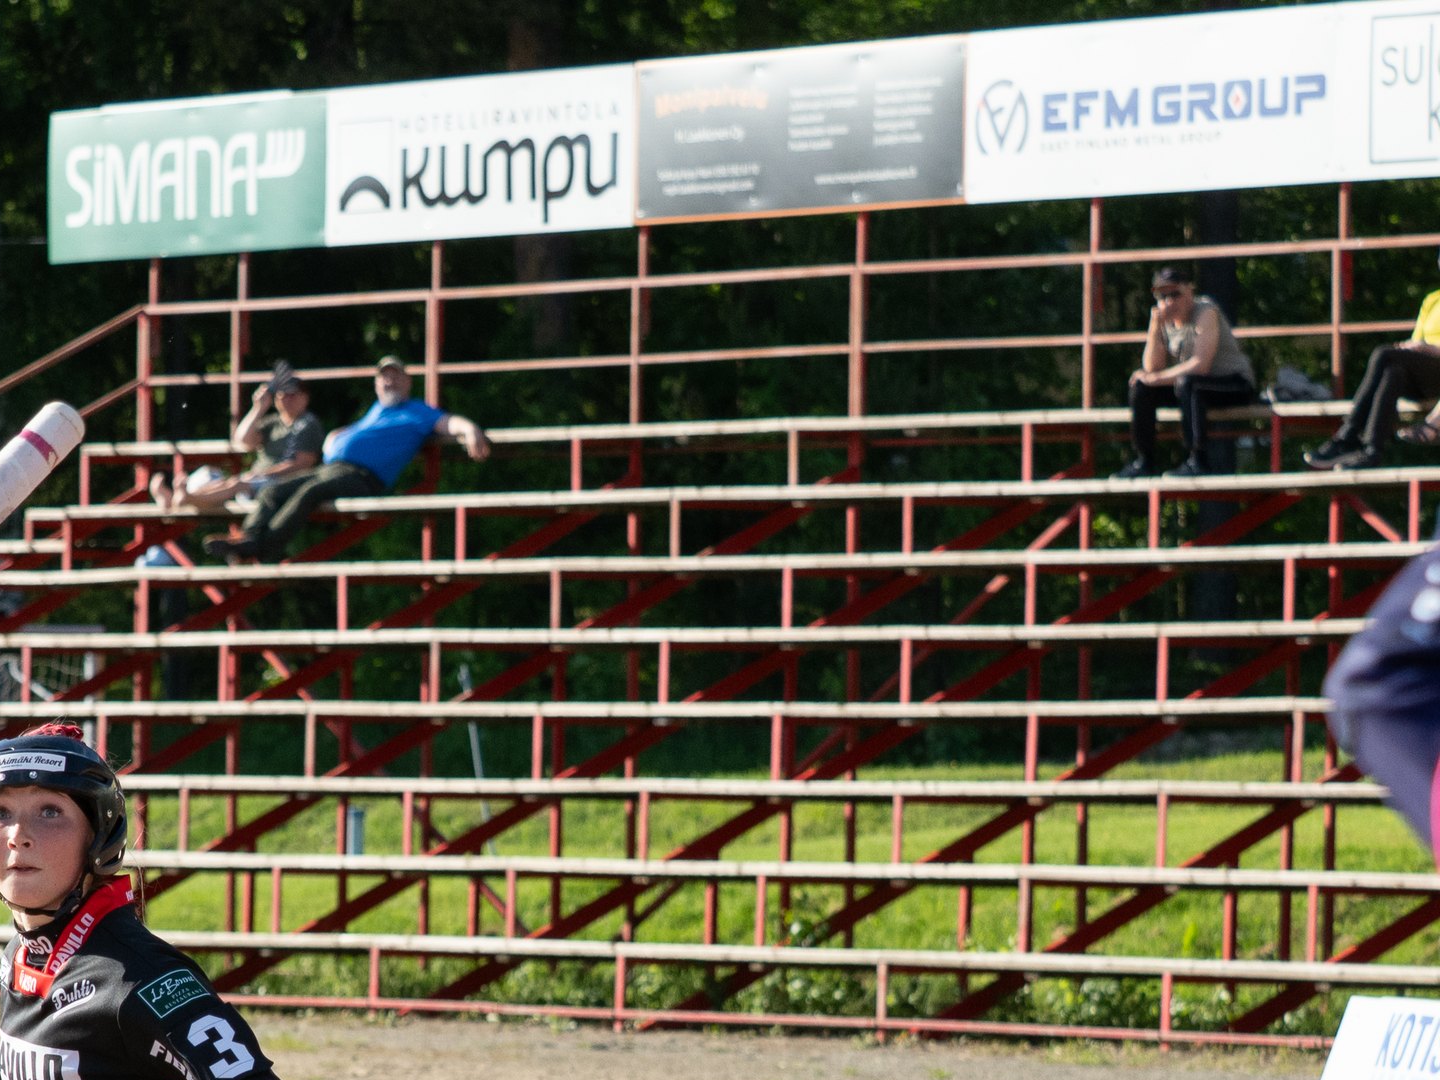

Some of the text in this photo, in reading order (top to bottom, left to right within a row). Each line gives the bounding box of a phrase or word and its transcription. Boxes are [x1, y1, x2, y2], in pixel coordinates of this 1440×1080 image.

[1042, 74, 1326, 133] EFM GROUP
[34, 755, 63, 767] Resort
[49, 912, 95, 974] PAVILLO
[51, 978, 96, 1012] Puhti
[187, 1014, 255, 1079] 3
